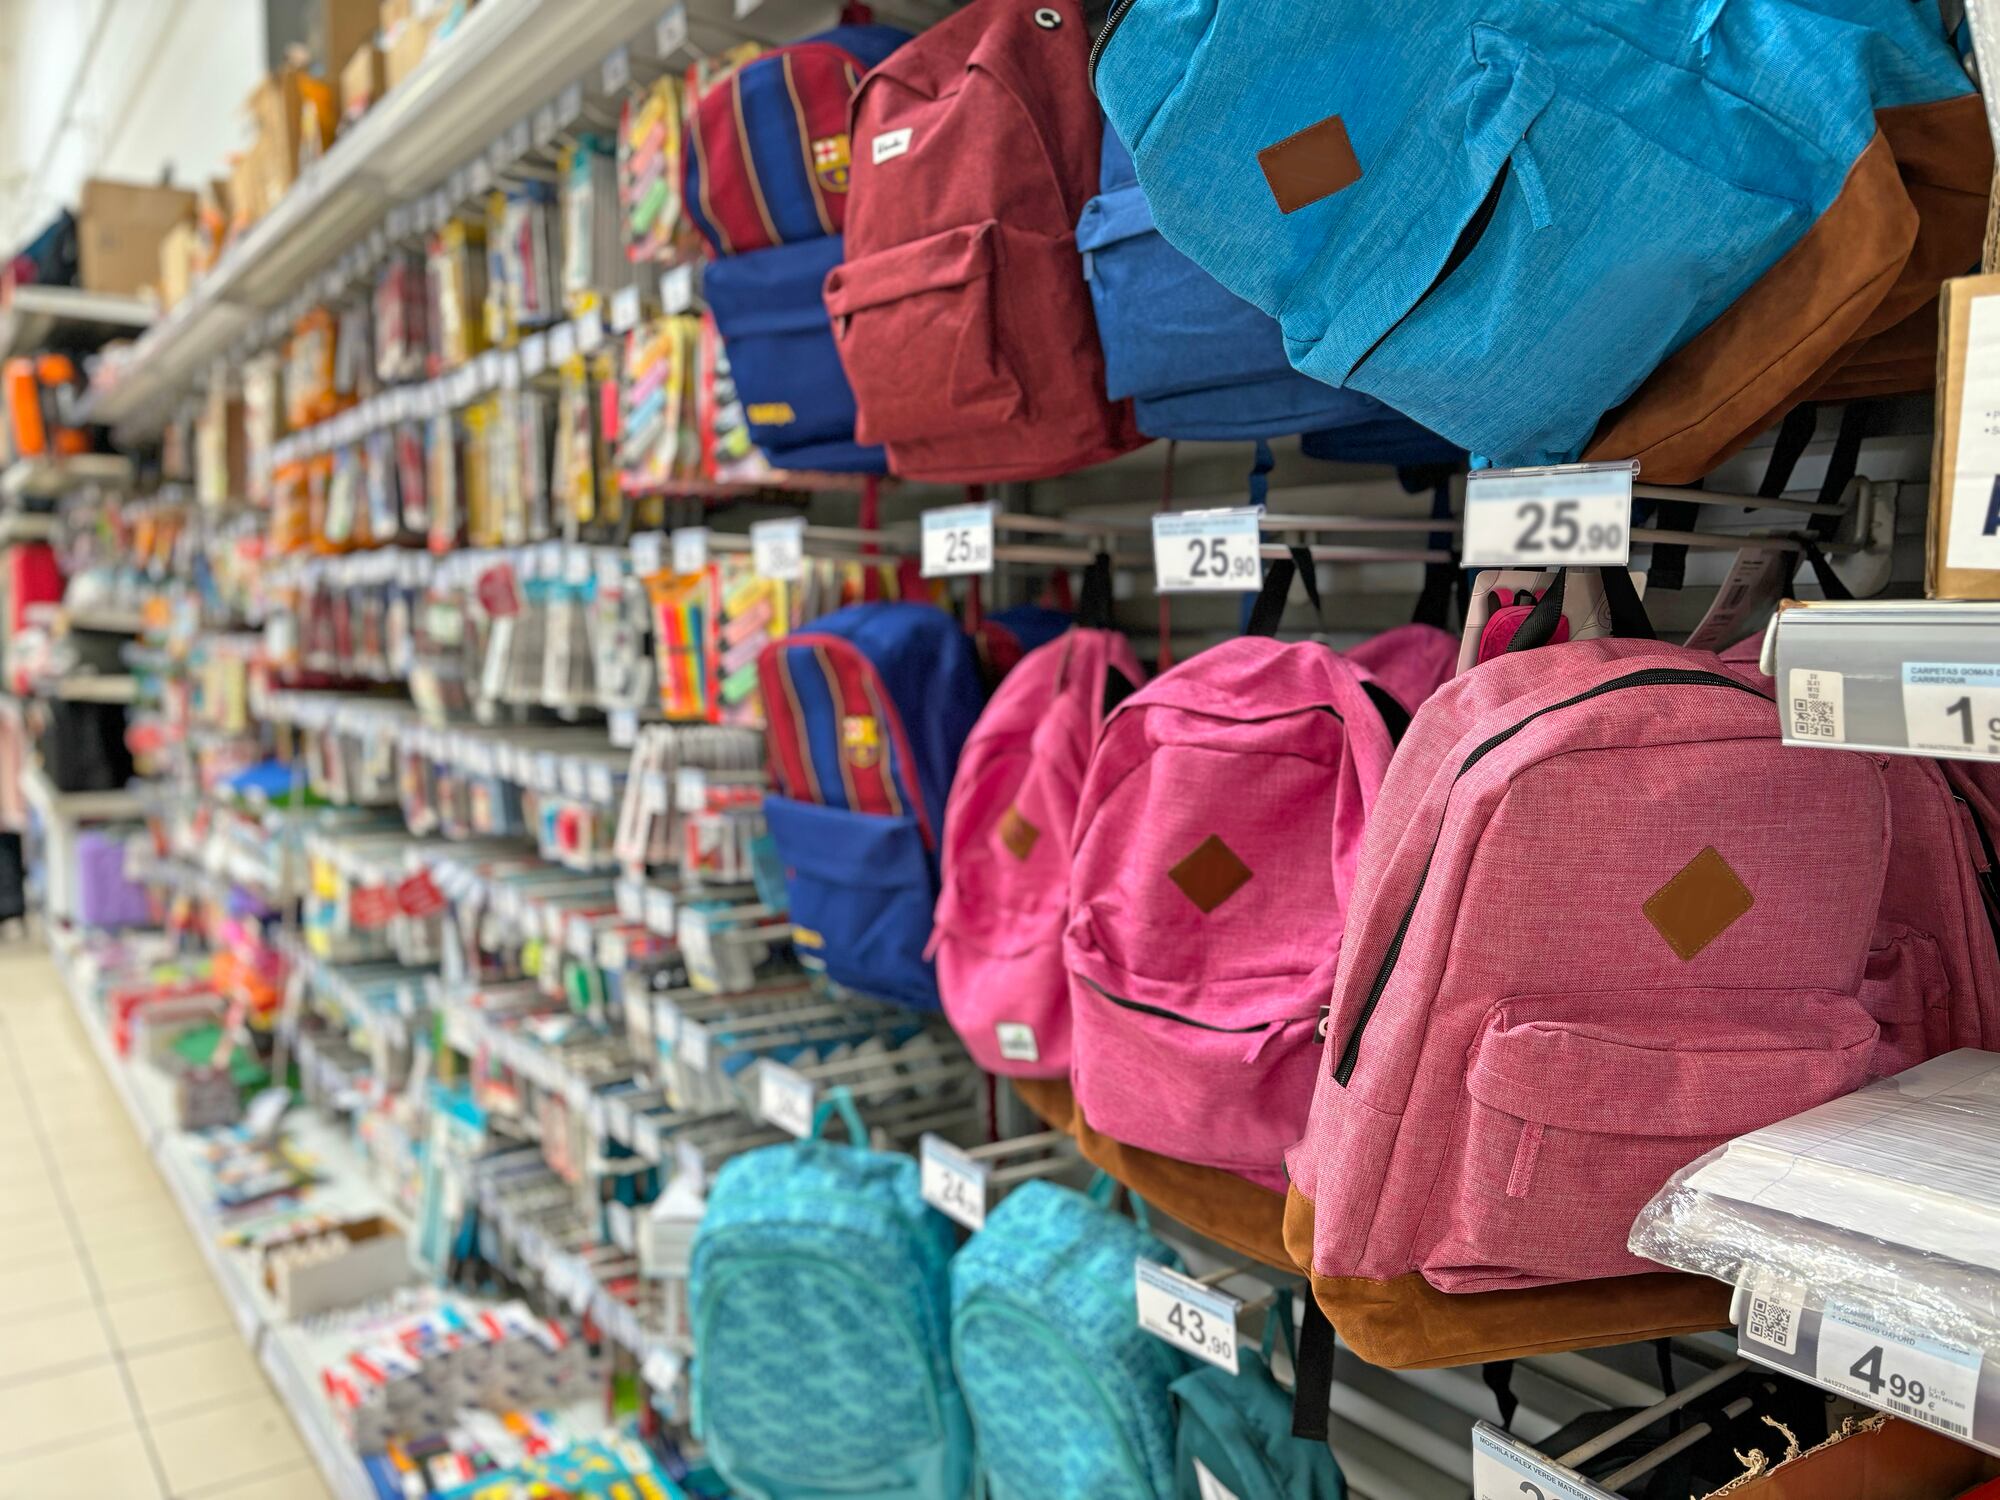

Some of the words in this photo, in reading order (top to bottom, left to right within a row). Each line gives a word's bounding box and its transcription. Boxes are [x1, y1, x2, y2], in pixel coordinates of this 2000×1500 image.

[1910, 667, 1958, 675] CARPETAS
[1960, 668, 1994, 676] GOMAS
[1910, 676, 1966, 684] CARREFOUR
[1480, 1436, 1509, 1457] MOCHILA
[1510, 1452, 1532, 1471] KALEX
[1533, 1467, 1557, 1485] VERDE
